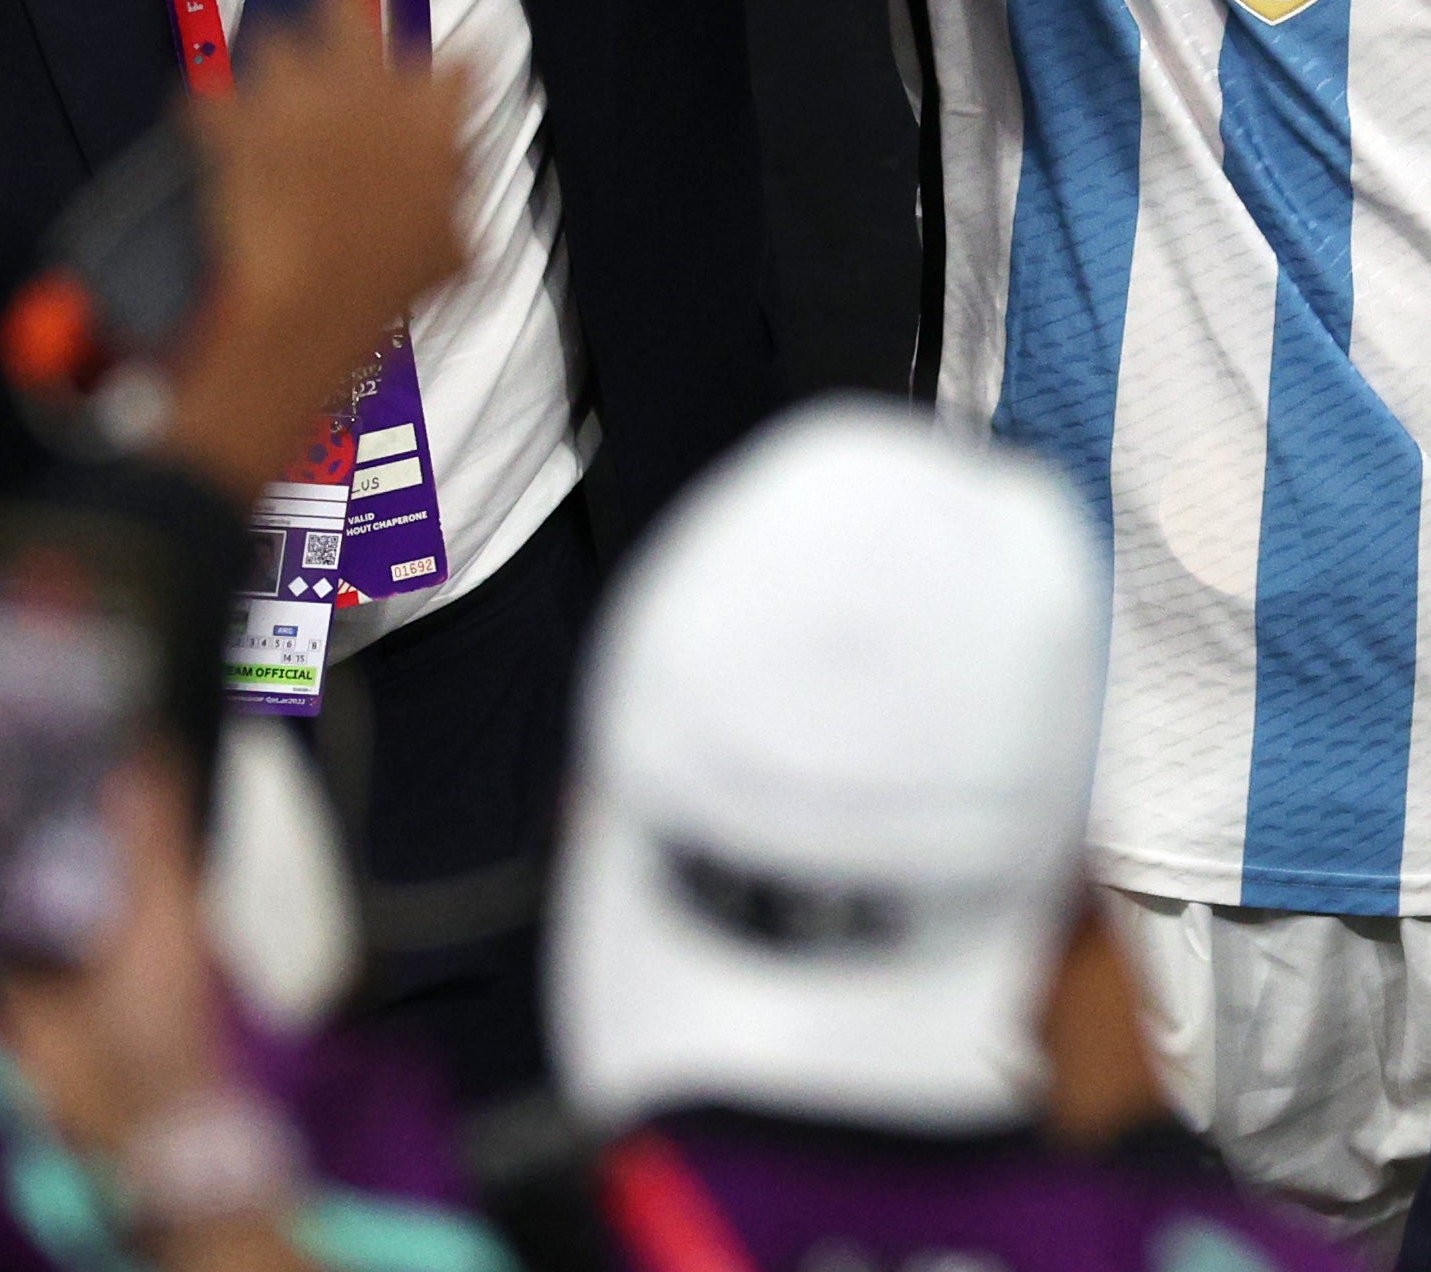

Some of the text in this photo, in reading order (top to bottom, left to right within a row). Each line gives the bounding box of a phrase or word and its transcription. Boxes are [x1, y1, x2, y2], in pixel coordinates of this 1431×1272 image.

[348, 512, 375, 525] VALID
[372, 510, 428, 531] CHAPERONE
[394, 558, 434, 579] 01692
[255, 668, 313, 680] OFFICIAL
